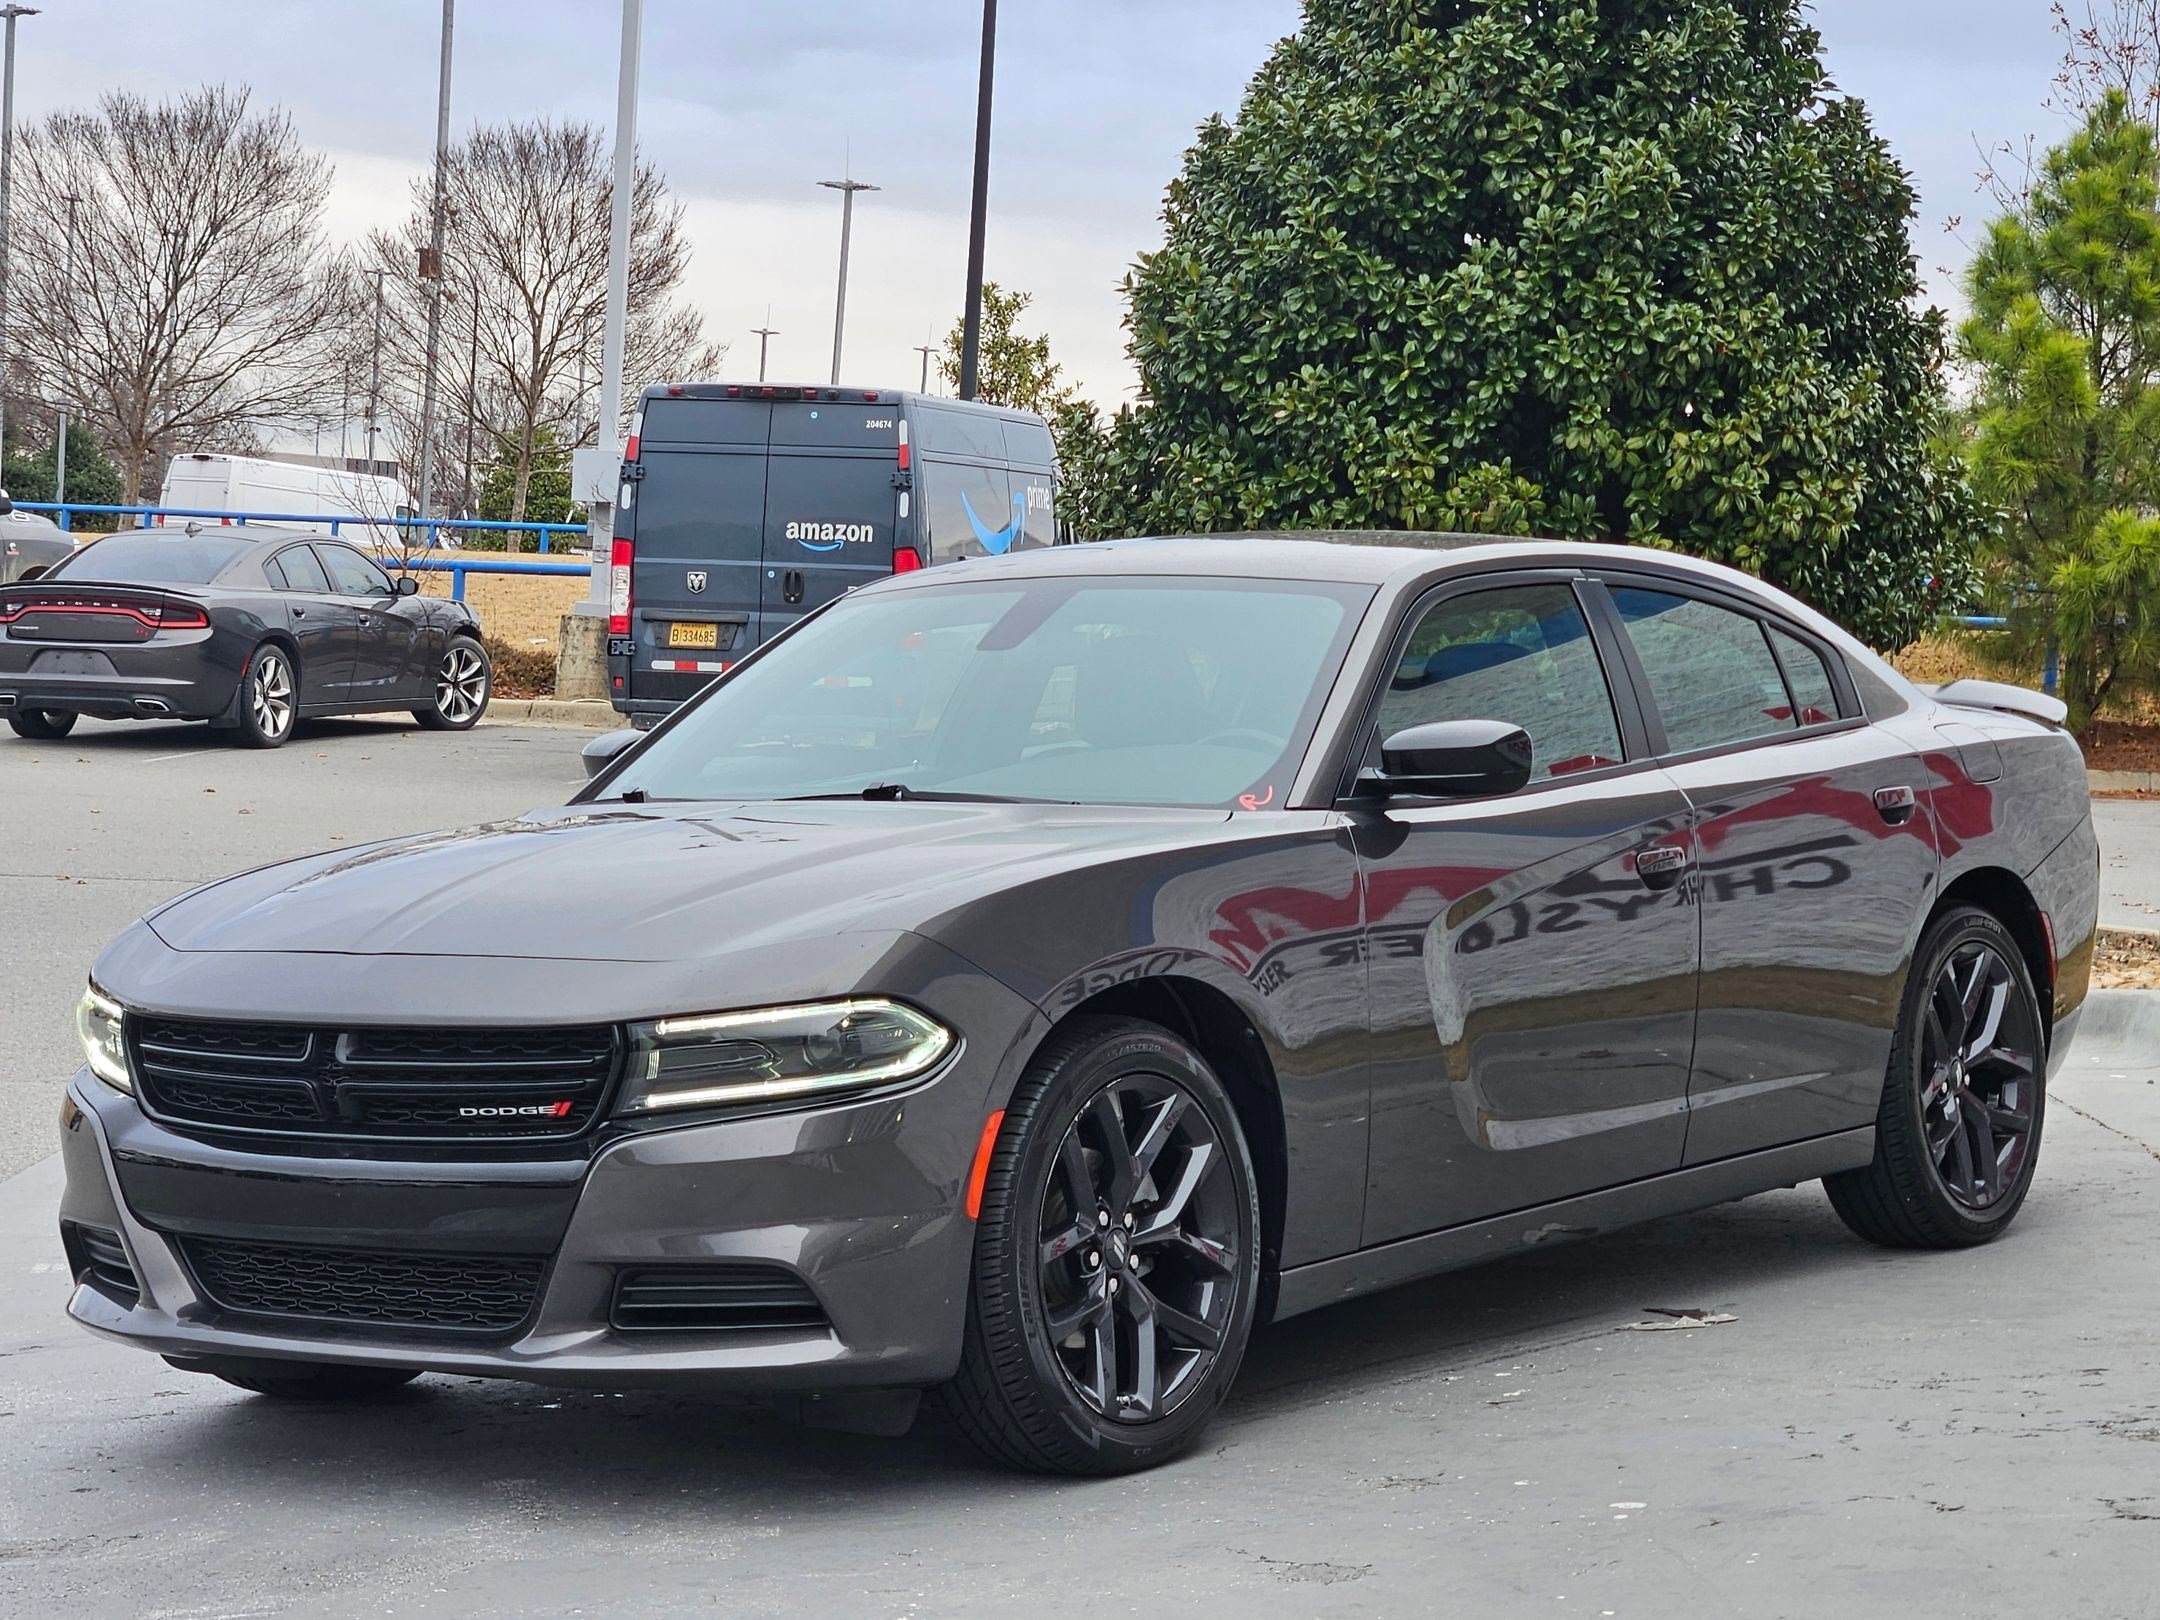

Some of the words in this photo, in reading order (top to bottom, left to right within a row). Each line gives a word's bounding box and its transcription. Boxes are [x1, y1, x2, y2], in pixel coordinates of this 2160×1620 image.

[865, 419, 892, 429] 204674
[1027, 477, 1050, 516] prime
[785, 521, 874, 543] amazon
[460, 1104, 558, 1116] DODGE
